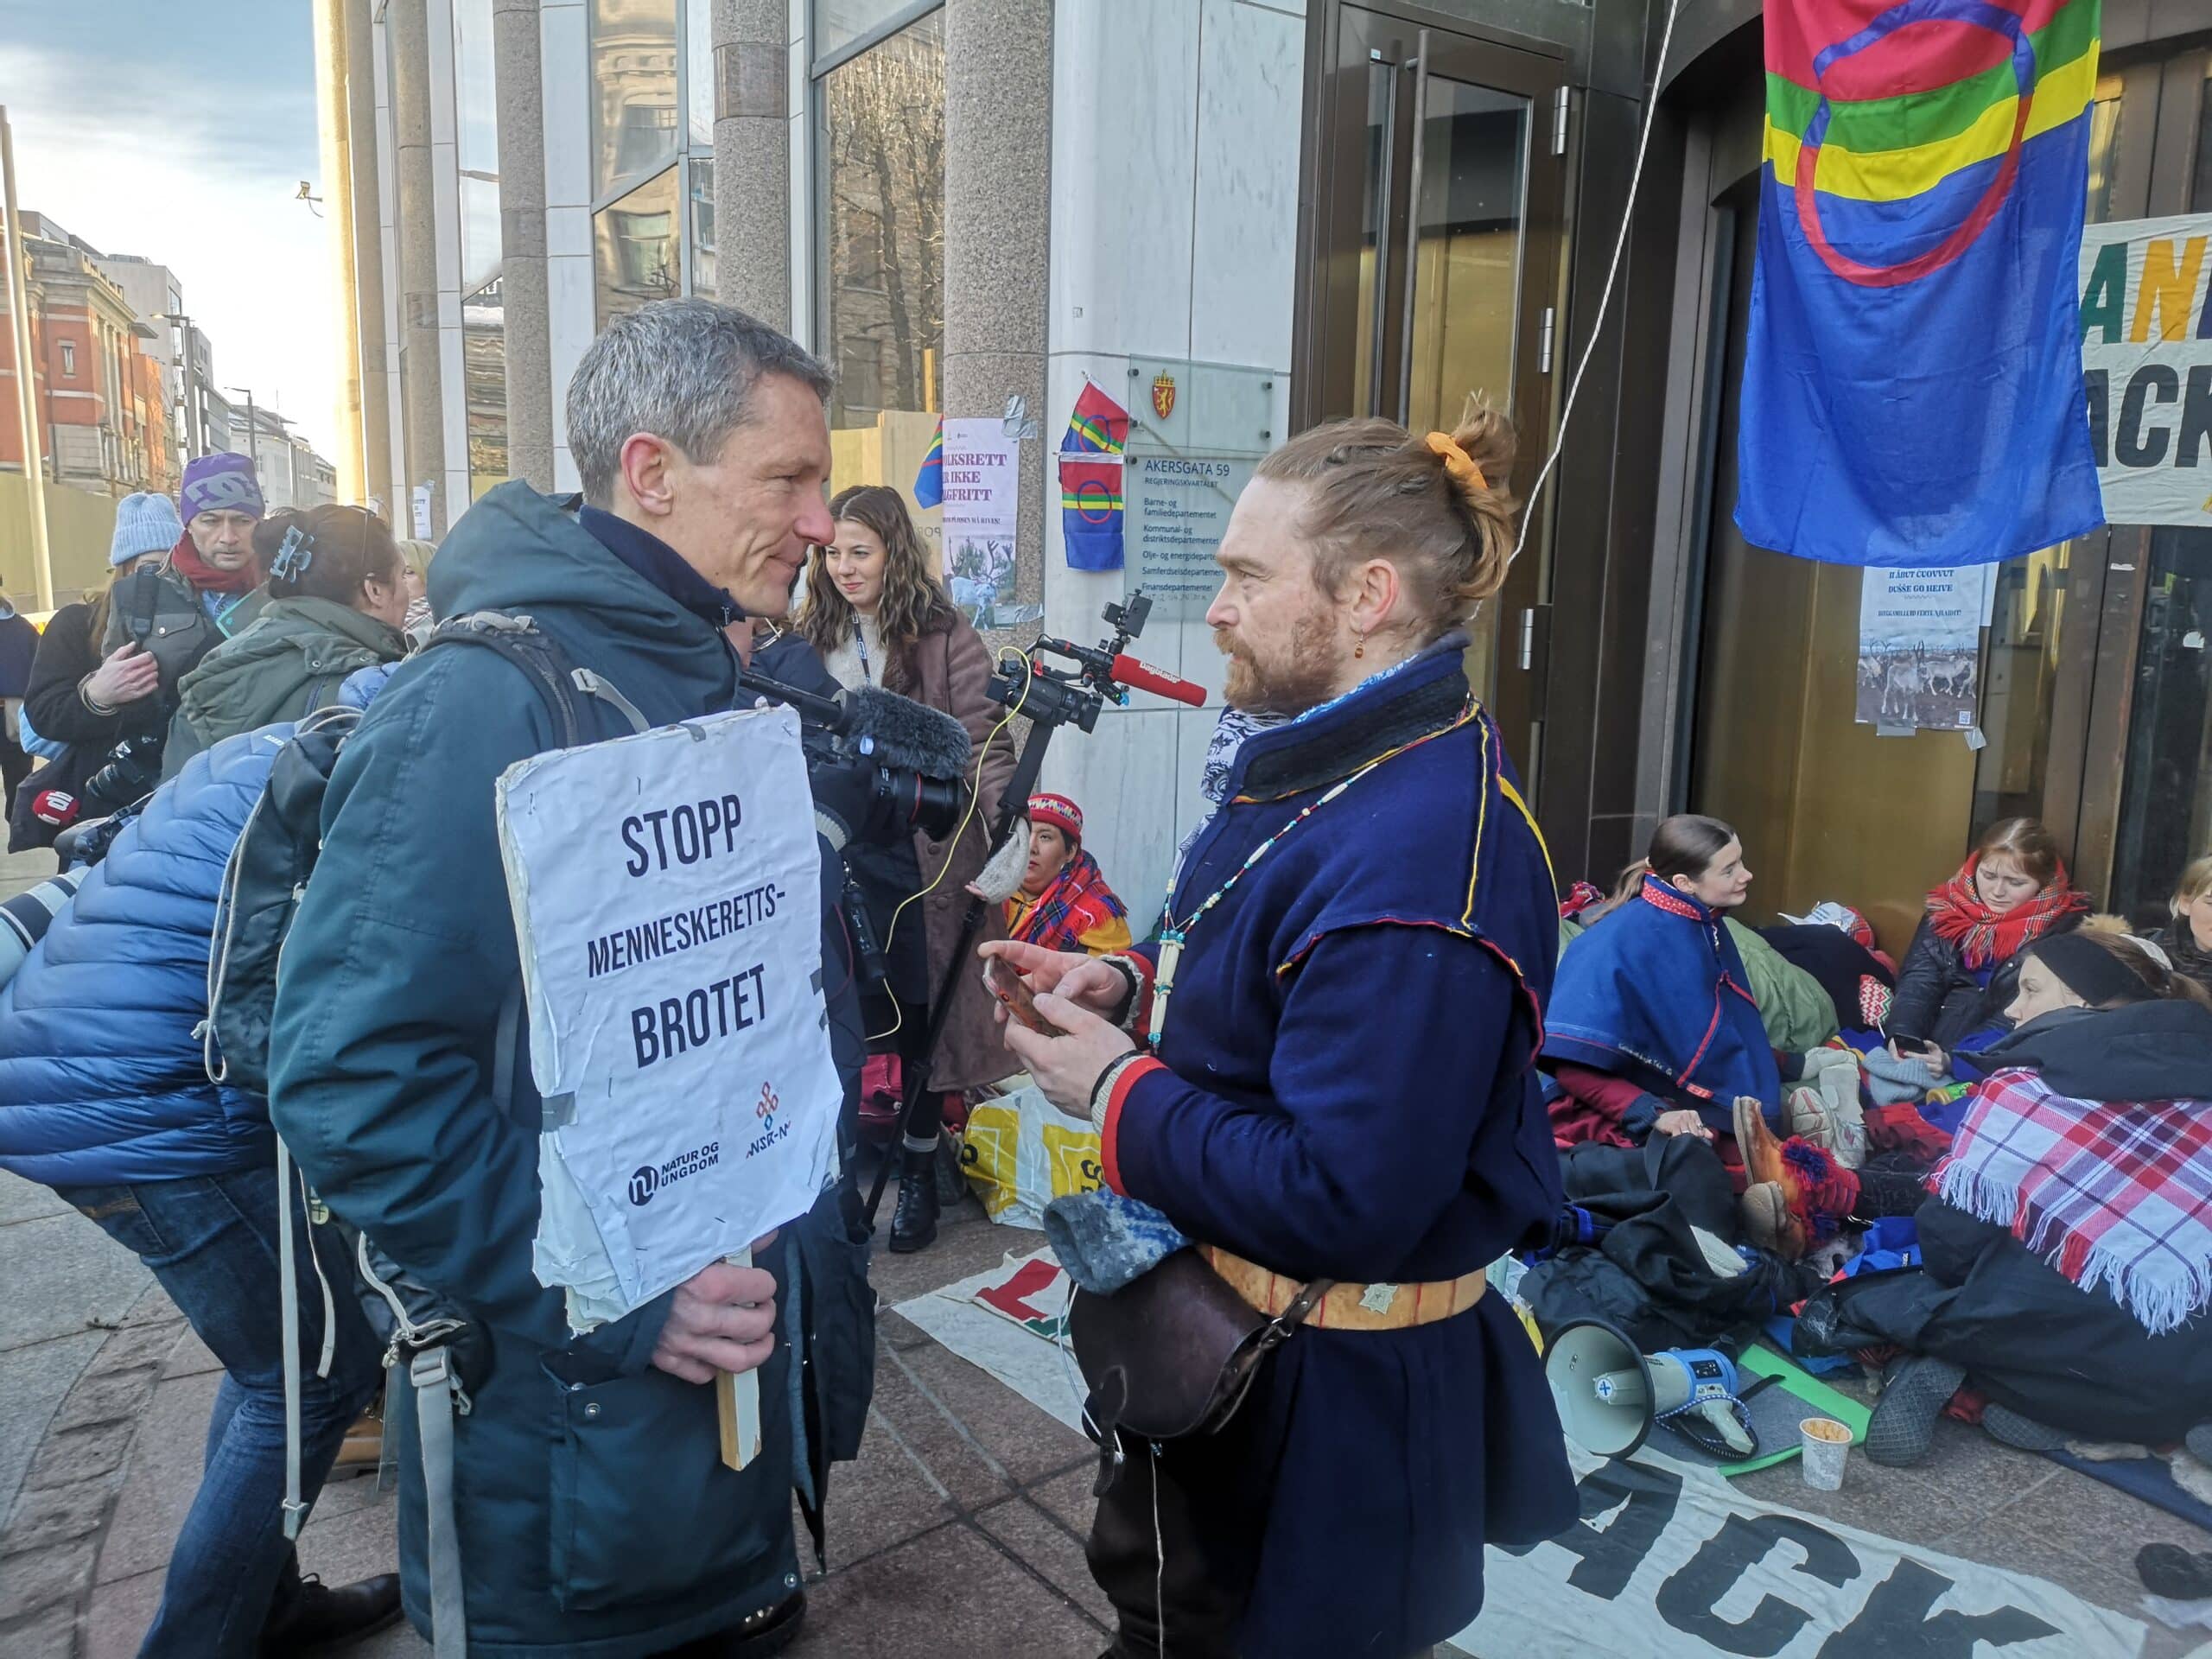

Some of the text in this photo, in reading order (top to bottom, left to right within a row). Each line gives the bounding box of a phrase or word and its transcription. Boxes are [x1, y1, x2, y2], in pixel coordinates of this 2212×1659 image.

[1145, 459, 1230, 476] AKERSGATA 59
[951, 471, 981, 484] IKKE
[1143, 498, 1167, 506] Barne-
[1143, 508, 1217, 518] familiedepartementet
[1143, 524, 1183, 534] Kommunal-
[1142, 536, 1219, 544] distriktsdepartementet
[1142, 550, 1159, 560] Olje-
[1141, 582, 1213, 592] Finansdepartementet
[1926, 583, 1953, 593] HEIVE
[621, 794, 742, 878] STOPP
[588, 883, 786, 979] MENNESKERETTS-
[631, 963, 766, 1070] BROTET
[661, 1141, 720, 1175] NATUR OG
[661, 1154, 720, 1187] UNGDOM
